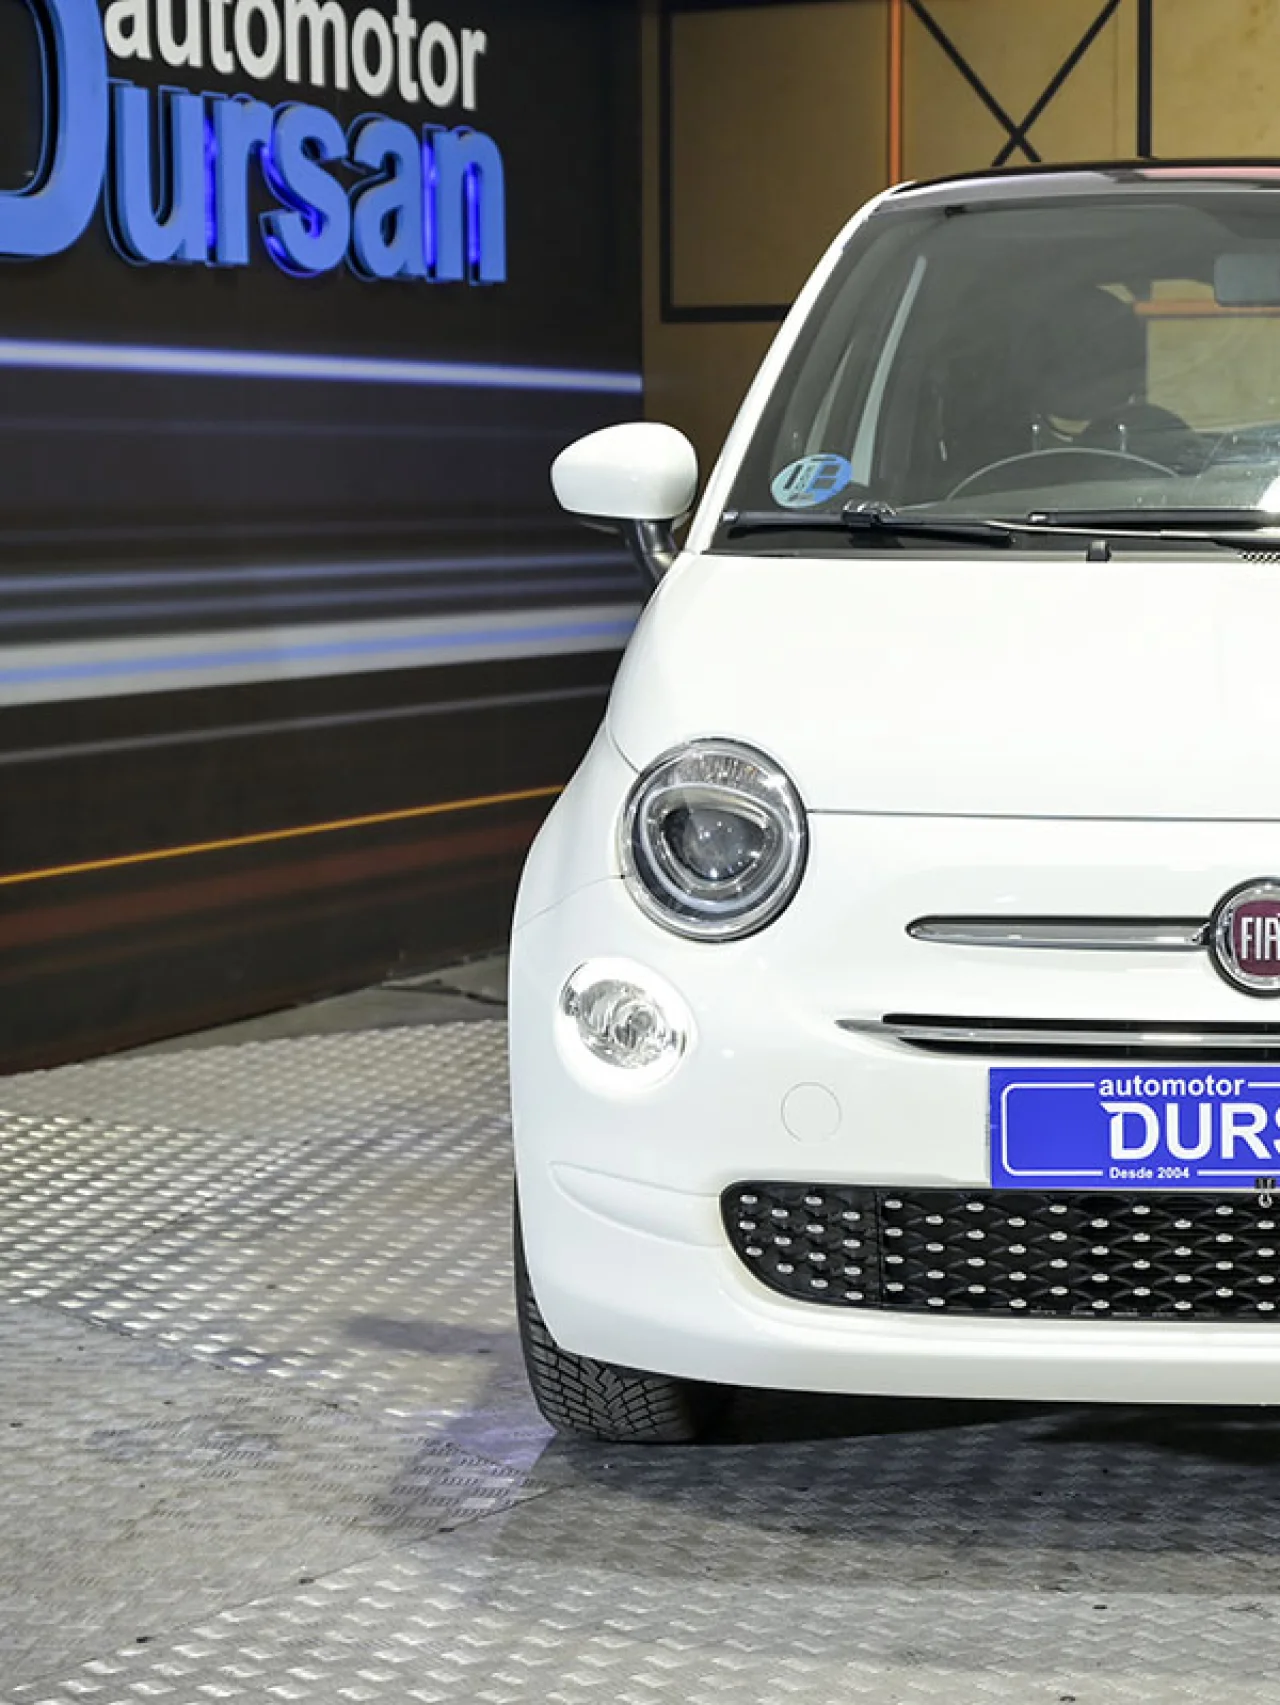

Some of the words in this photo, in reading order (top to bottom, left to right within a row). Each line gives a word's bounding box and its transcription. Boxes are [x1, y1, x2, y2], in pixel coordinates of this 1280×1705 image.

[103, 0, 487, 110] automotor
[1099, 1074, 1245, 1097] automotor
[1109, 1166, 1153, 1179] Desde
[1157, 1166, 1190, 1179] 2004
